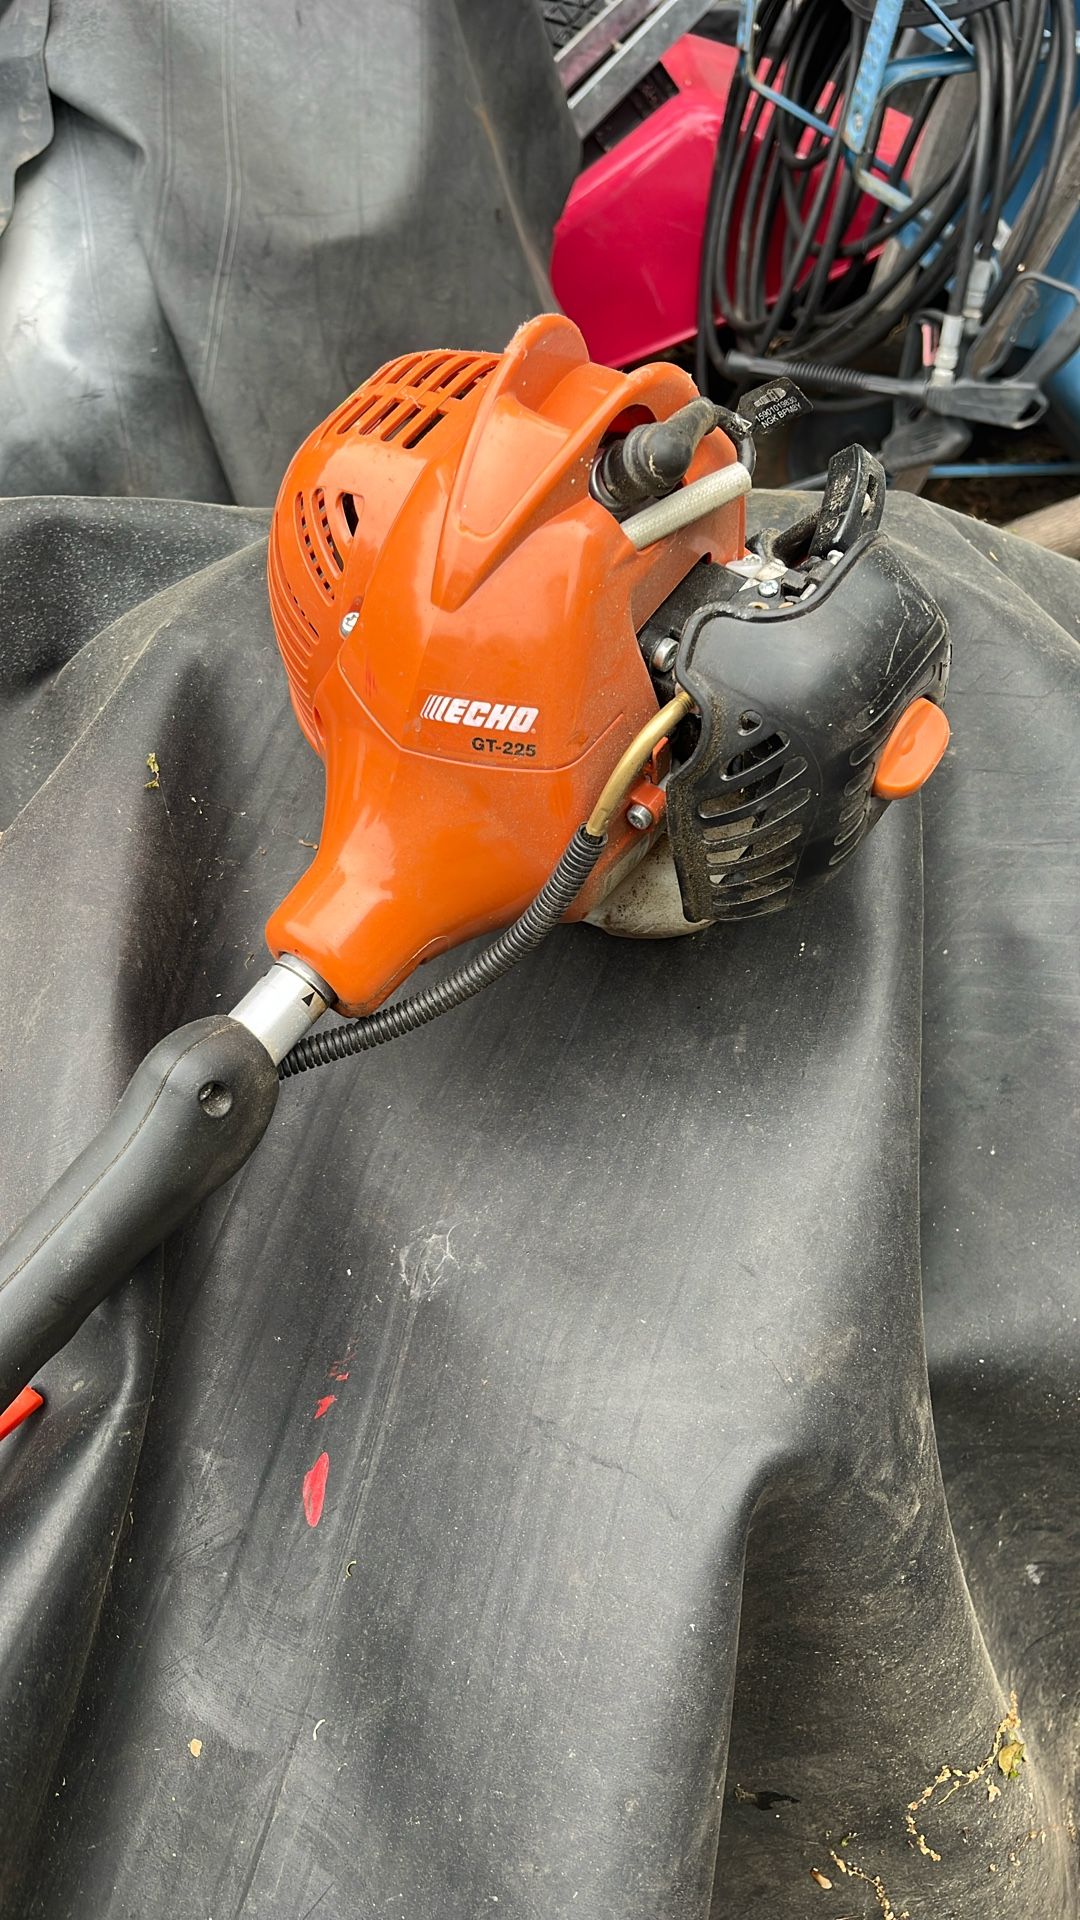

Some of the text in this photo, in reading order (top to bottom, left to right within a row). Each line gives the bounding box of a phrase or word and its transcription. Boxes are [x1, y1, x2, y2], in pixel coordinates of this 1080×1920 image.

[760, 414, 779, 429] NGK
[443, 697, 539, 733] ECHO
[471, 737, 537, 757] GT-225
